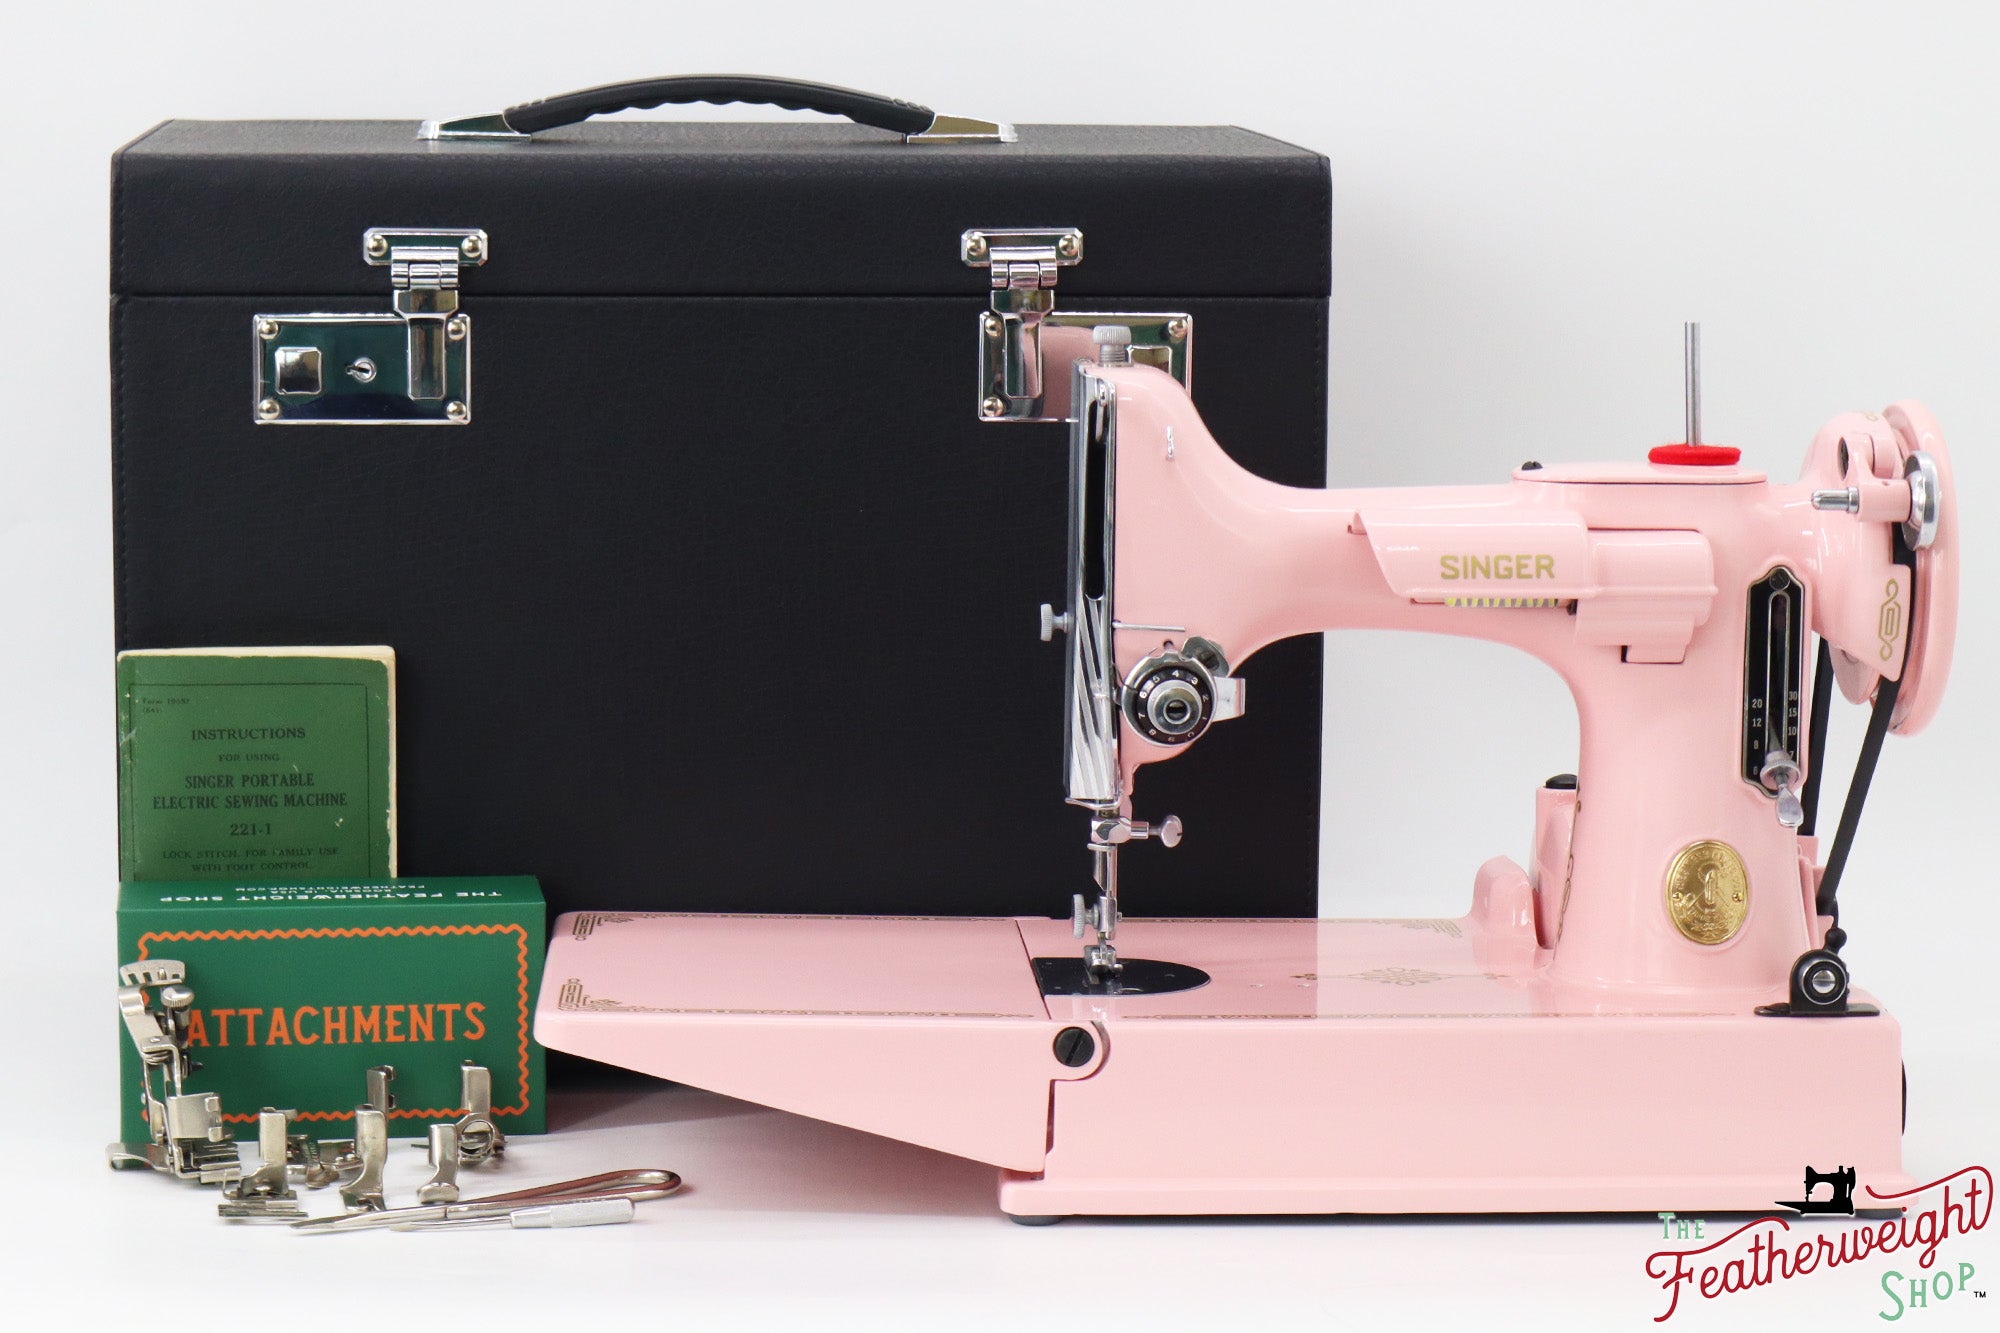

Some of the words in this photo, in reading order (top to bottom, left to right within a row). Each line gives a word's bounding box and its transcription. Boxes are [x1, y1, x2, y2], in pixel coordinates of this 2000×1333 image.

[1440, 554, 1555, 580] SINGER
[1171, 669, 1180, 678] 4
[1152, 675, 1161, 684] 5
[1190, 676, 1199, 685] 3
[1138, 690, 1148, 699] 6
[1788, 690, 1798, 701] 30
[1751, 698, 1763, 709] 20
[1788, 707, 1798, 718] 15
[1752, 718, 1762, 728] 12
[191, 728, 306, 741] INSTRUCTIONS
[1787, 726, 1797, 736] 10
[1753, 739, 1759, 750] 8
[218, 754, 241, 762] FOR
[246, 753, 280, 762] USING
[1753, 766, 1759, 776] 6
[185, 775, 234, 789] SINGER
[241, 773, 315, 788] PORTABLE
[153, 796, 219, 810] ELECTRIC
[225, 794, 279, 809] SEWING
[284, 792, 347, 807] MACHINE
[230, 823, 272, 837] 221-1
[163, 850, 192, 859] LOCK
[246, 849, 267, 858] FOR
[273, 848, 313, 857] FAMILY
[319, 847, 339, 856] USE
[191, 863, 222, 873] WITH
[227, 863, 255, 872] FOOT
[261, 861, 311, 870] CONTROL
[236, 892, 443, 901] FEATHERWEIGHT
[187, 1002, 486, 1047] ATTACHMENTS
